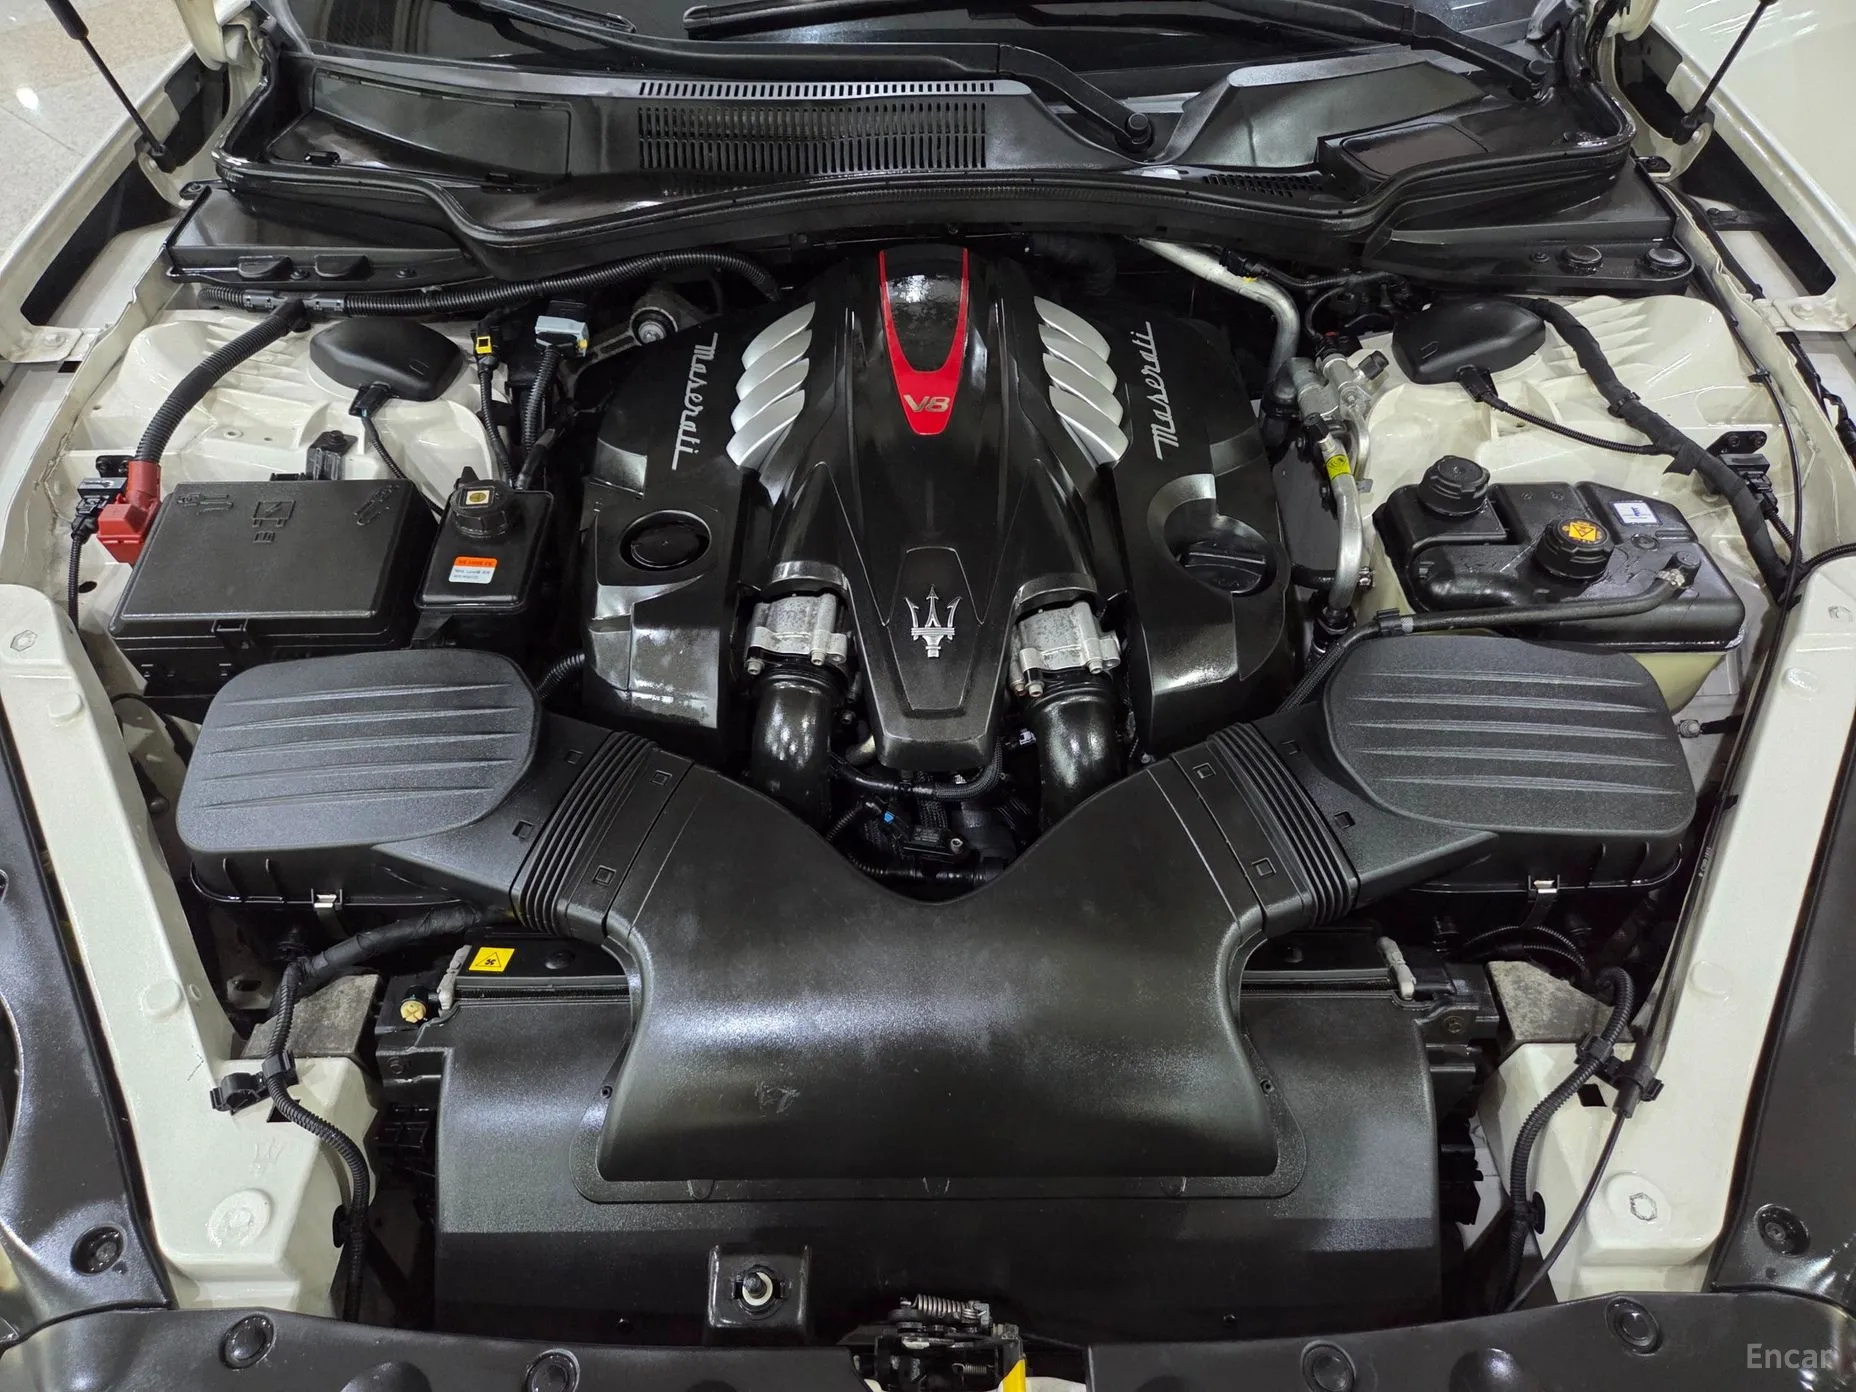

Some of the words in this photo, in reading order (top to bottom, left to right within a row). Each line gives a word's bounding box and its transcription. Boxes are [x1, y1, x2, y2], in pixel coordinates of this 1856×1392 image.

[671, 332, 719, 470] Maserati
[903, 394, 950, 413] V8
[1130, 320, 1179, 460] Maserati
